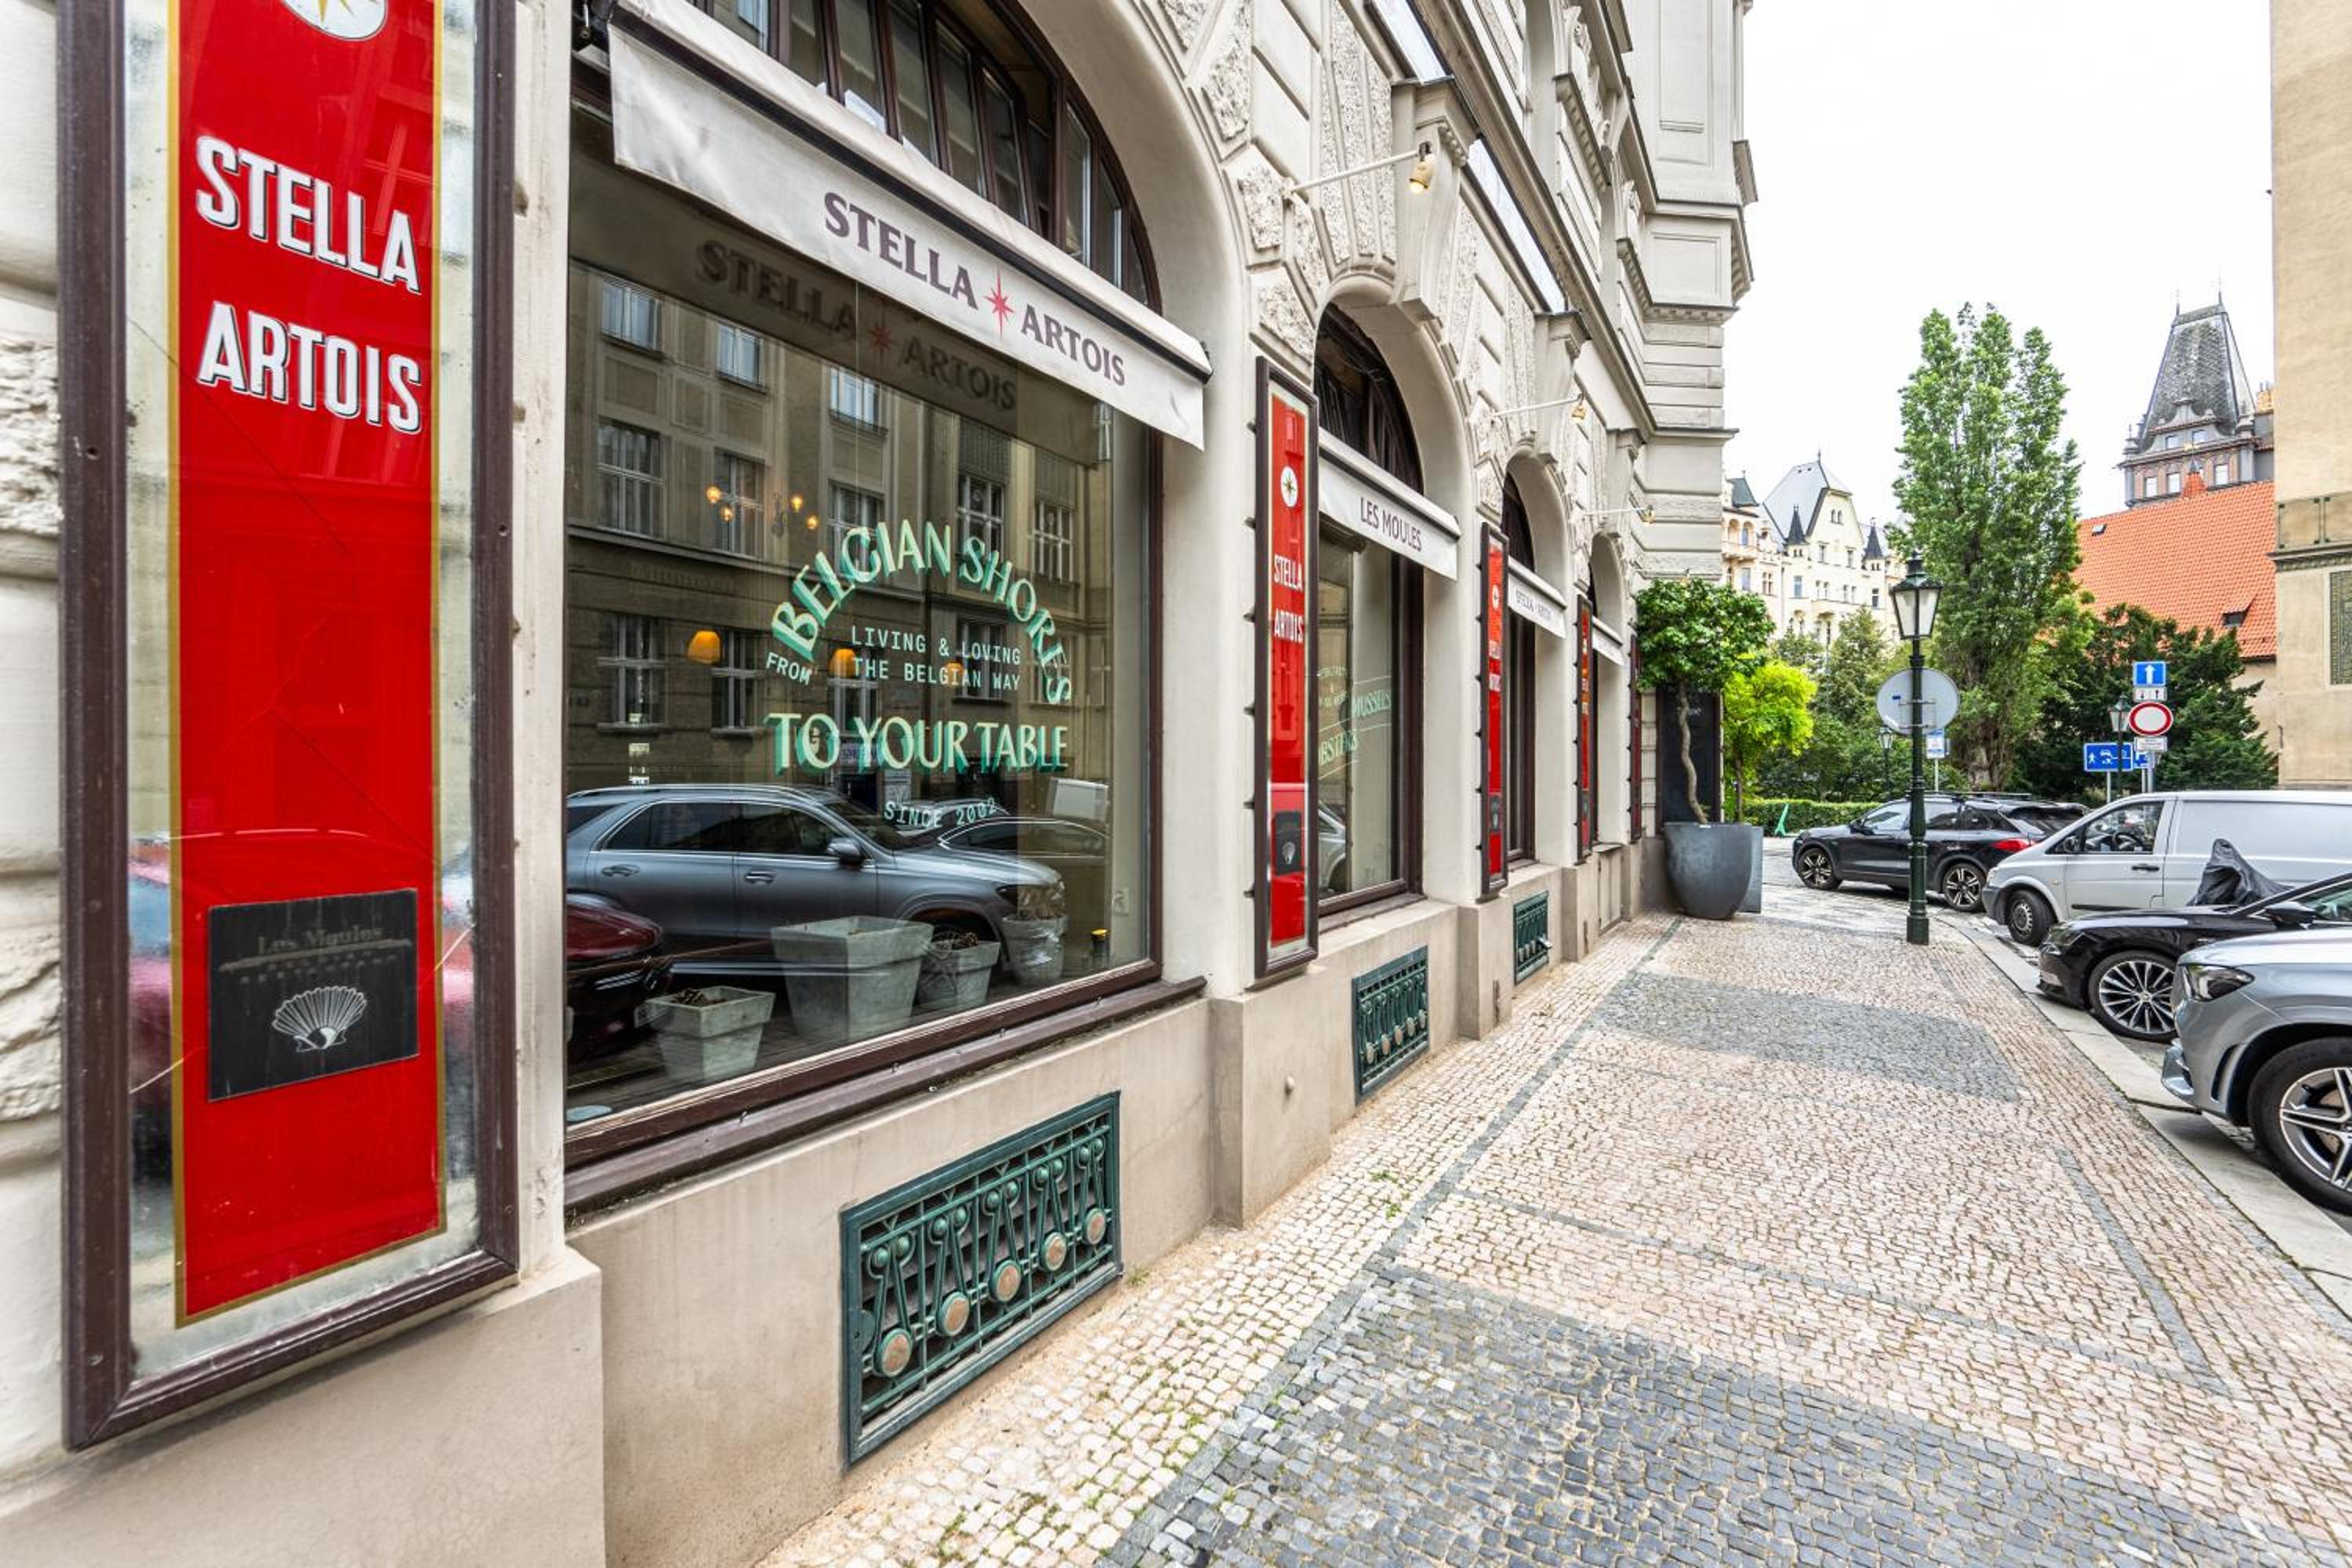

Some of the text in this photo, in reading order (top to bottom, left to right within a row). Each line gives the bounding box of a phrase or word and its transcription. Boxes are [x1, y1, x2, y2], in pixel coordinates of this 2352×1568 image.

[196, 135, 422, 295] STELLA
[824, 191, 1126, 387] STELLA ARTOIS
[696, 238, 1017, 412] STELLA ARTOIS
[196, 300, 422, 434] ARTOIS
[1360, 497, 1422, 553] LES MOULES
[1274, 554, 1303, 592] STELLA
[851, 626, 1020, 665] LIVING & LOVING
[959, 536, 1072, 704] SHORES
[765, 652, 812, 686] FROM
[853, 657, 1020, 691] THE BELGIAN WAY
[764, 713, 1069, 776] TO YOUR TABLE
[884, 797, 997, 828] SINCE 2002
